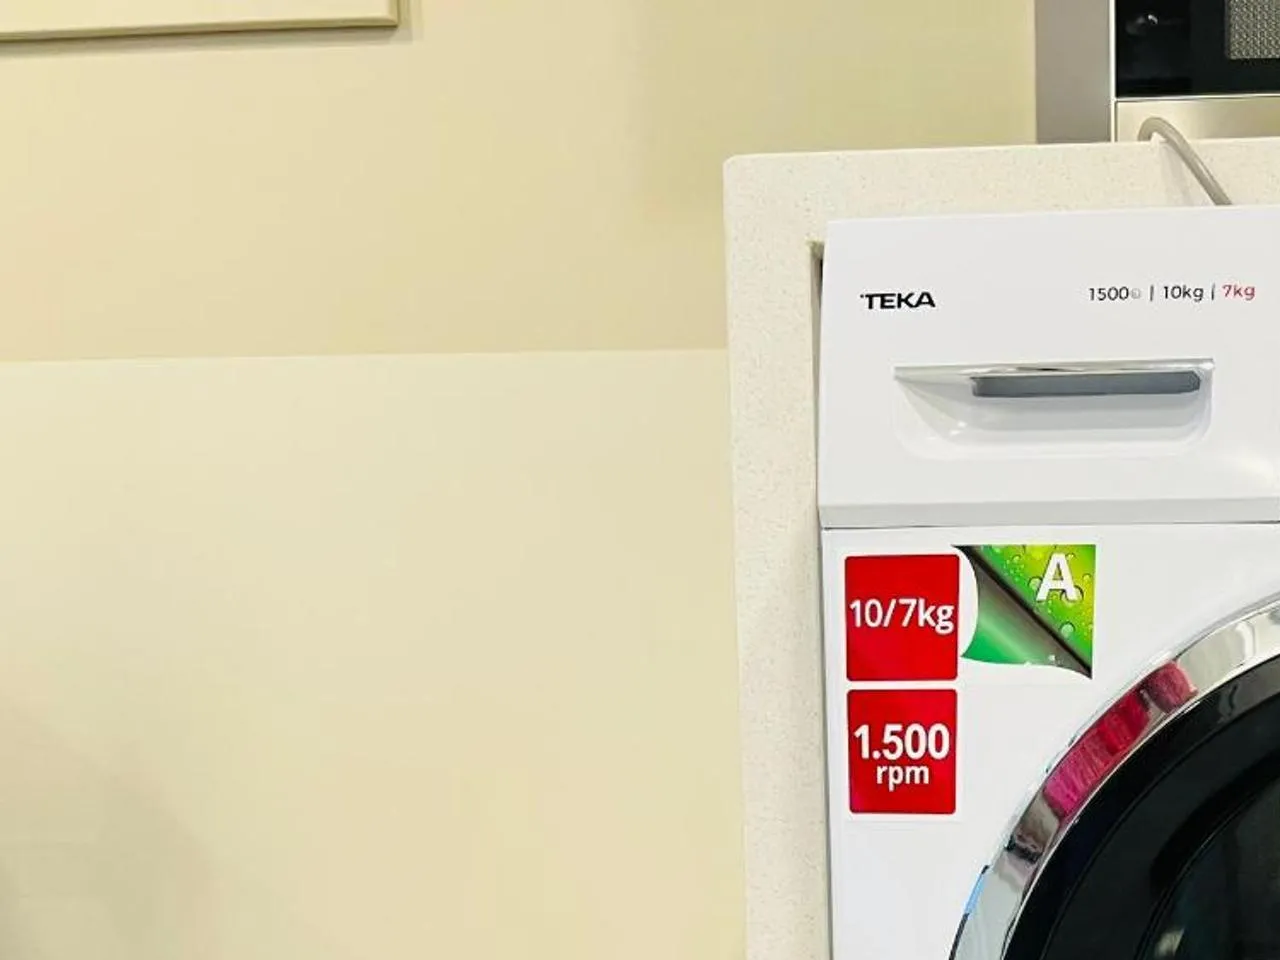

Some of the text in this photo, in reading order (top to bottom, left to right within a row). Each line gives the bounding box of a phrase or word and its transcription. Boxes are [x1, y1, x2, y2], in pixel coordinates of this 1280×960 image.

[860, 291, 936, 310] TEKA
[1088, 284, 1256, 303] 1500 10kg 7kg
[1035, 552, 1082, 602] A
[849, 597, 956, 636] 10/7kg
[853, 723, 951, 761] 1.500
[876, 762, 930, 792] rpm
